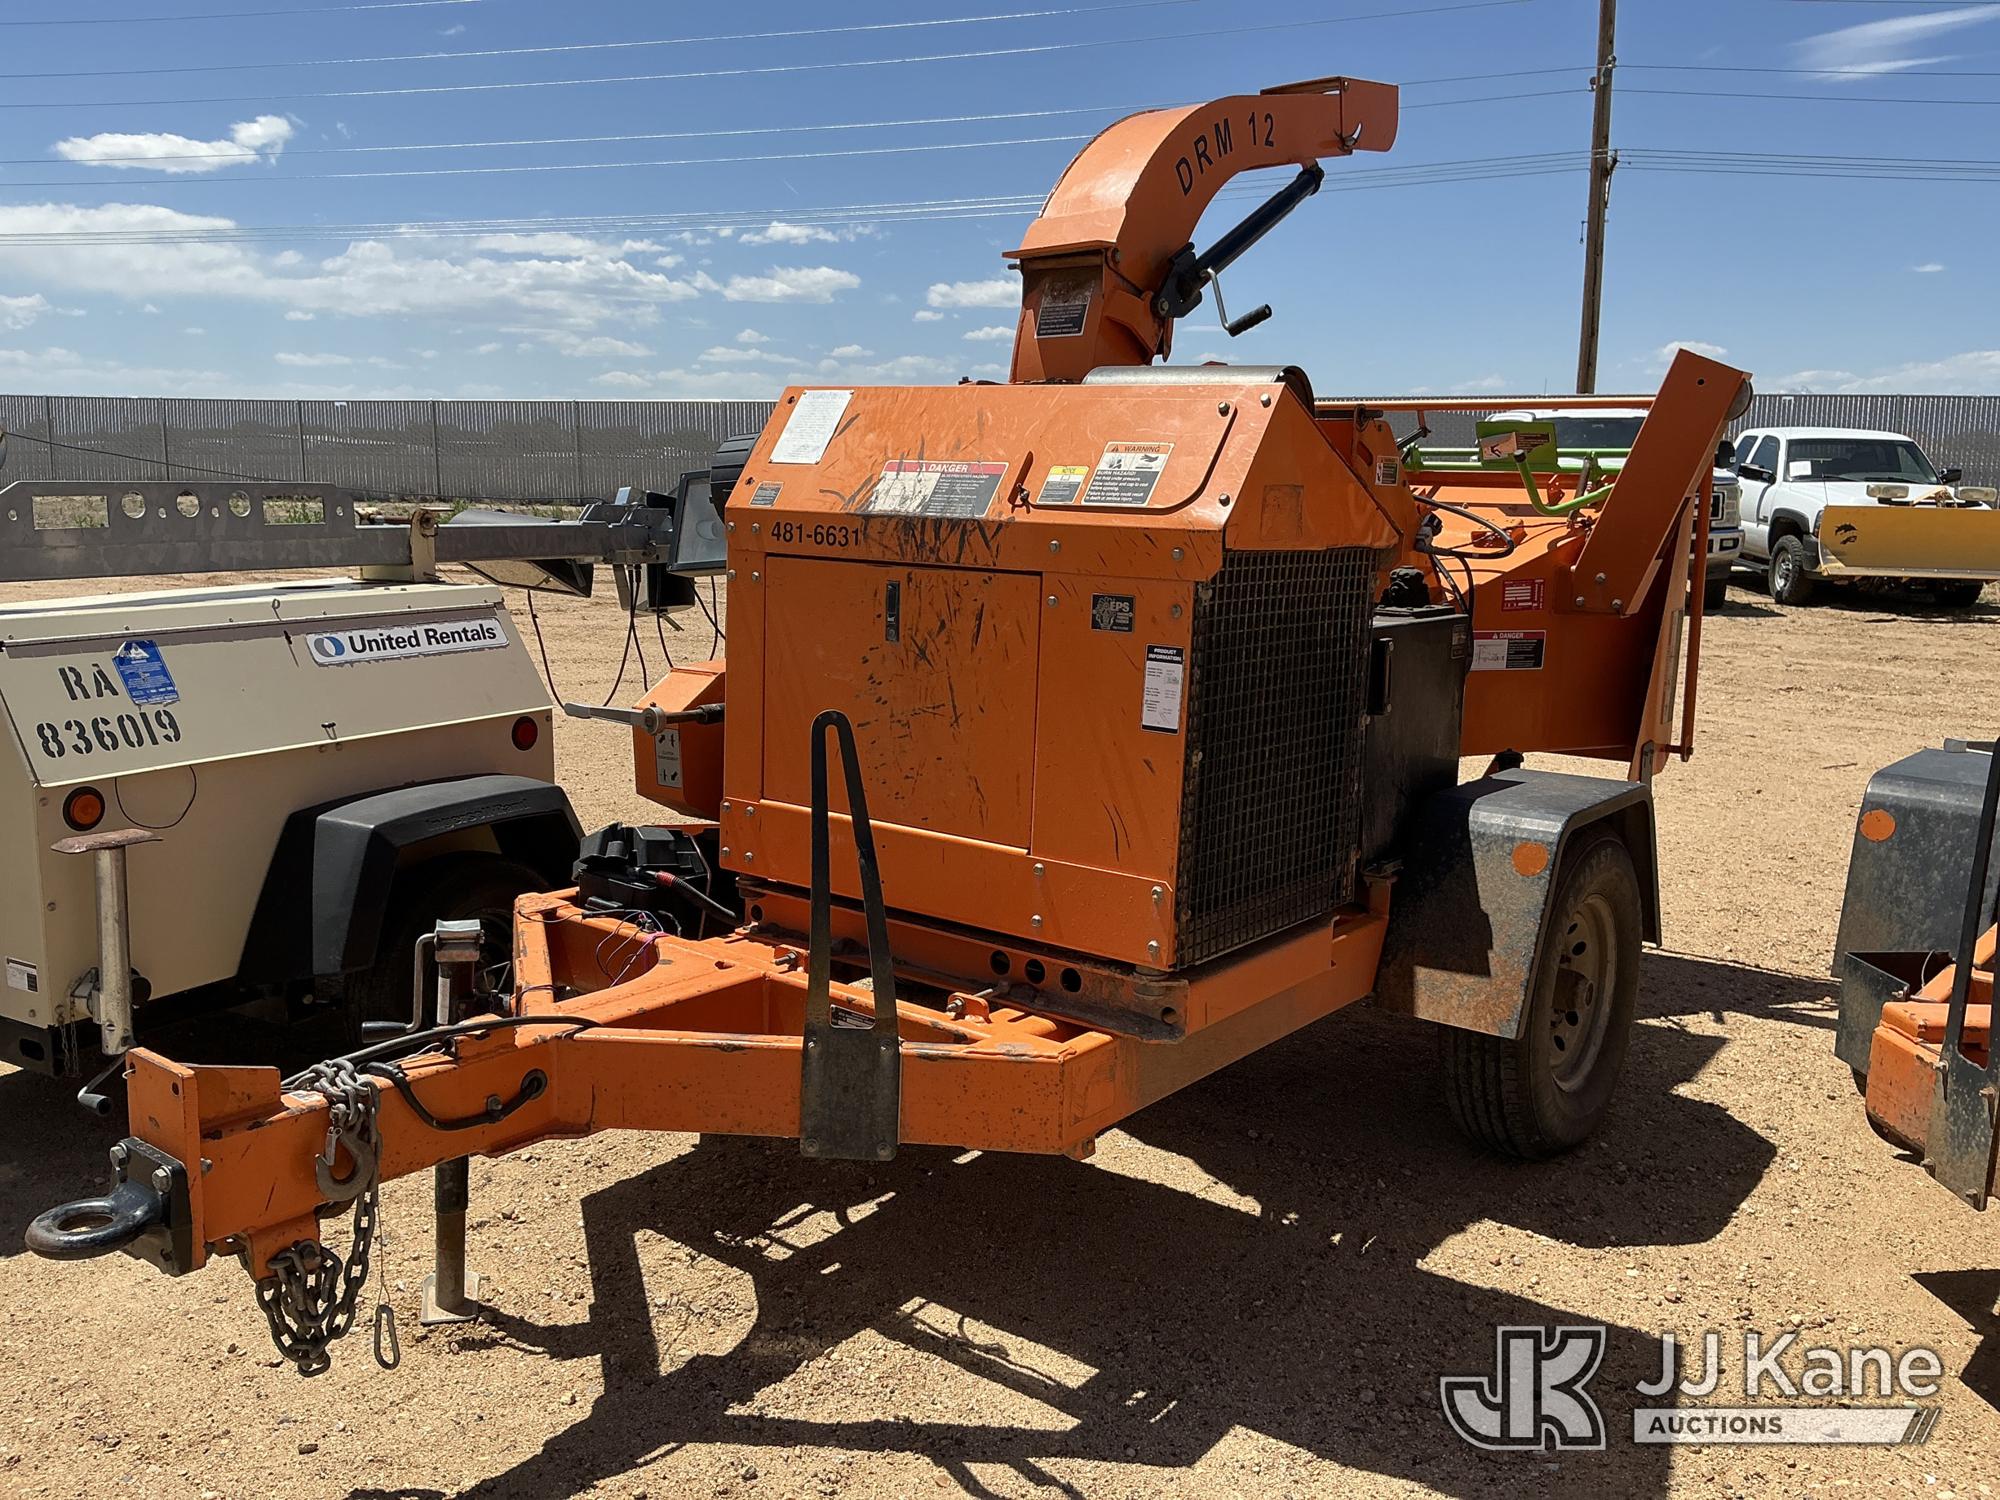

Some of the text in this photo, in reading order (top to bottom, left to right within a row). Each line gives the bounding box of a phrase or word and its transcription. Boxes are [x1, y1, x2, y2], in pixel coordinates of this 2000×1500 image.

[1175, 111, 1274, 197] DRM 12
[1124, 445, 1160, 453] WARNING
[928, 463, 969, 473] DANGER
[771, 521, 859, 547] 481-6631
[1110, 601, 1130, 613] EPS
[348, 624, 497, 654] United Rentals
[58, 663, 119, 701] RA
[36, 709, 181, 758] 836019
